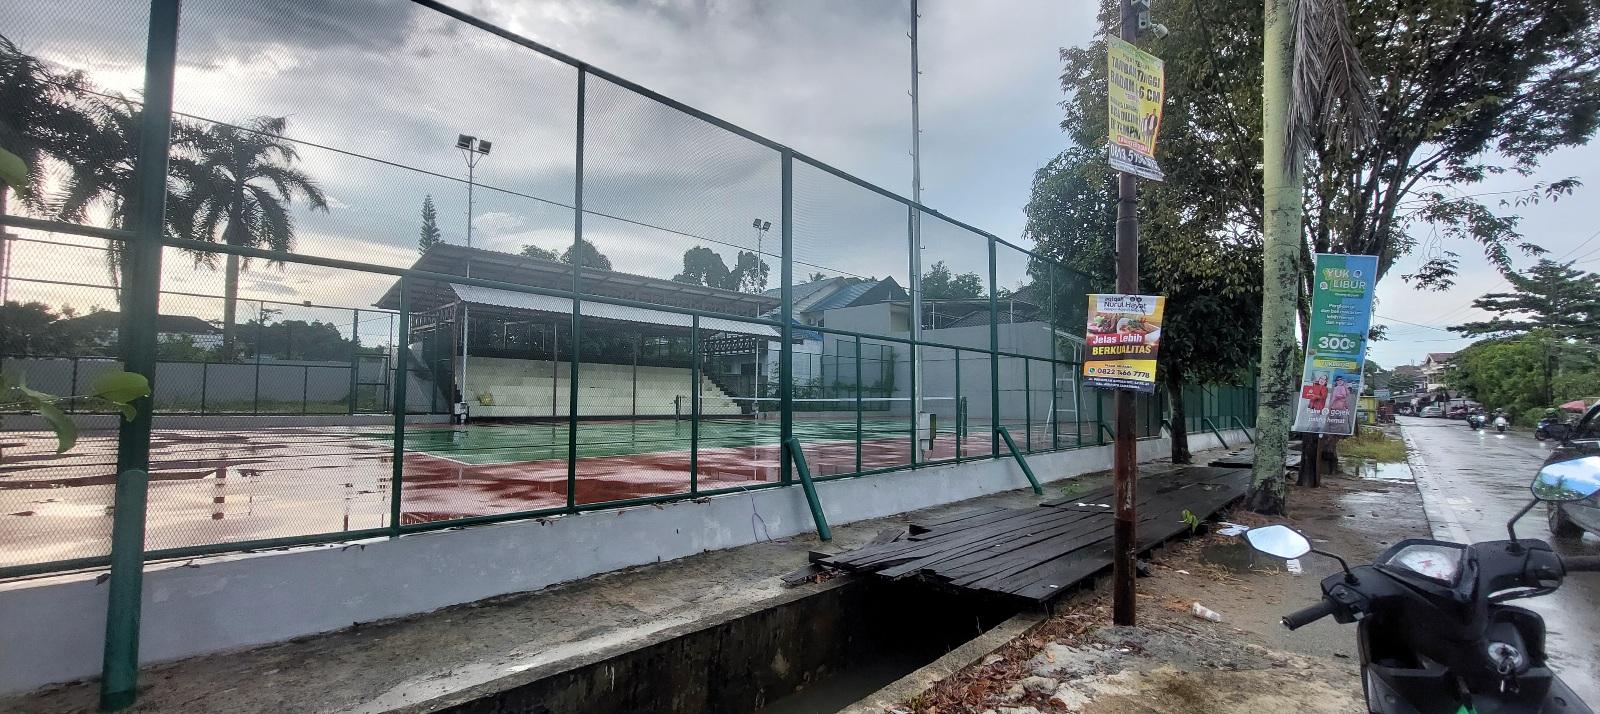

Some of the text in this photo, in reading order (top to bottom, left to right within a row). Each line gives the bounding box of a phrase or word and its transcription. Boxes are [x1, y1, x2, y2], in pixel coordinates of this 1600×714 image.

[1137, 70, 1160, 88] TINGGI
[1147, 89, 1160, 104] CM
[1326, 268, 1349, 278] YUK
[1333, 280, 1366, 289] LIBUR
[1125, 302, 1147, 310] Hayat
[1093, 333, 1143, 344] Jelas Lebih
[1092, 345, 1152, 356] BERKUALITAS
[1133, 371, 1150, 379] 7778
[1330, 408, 1350, 417] gojek
